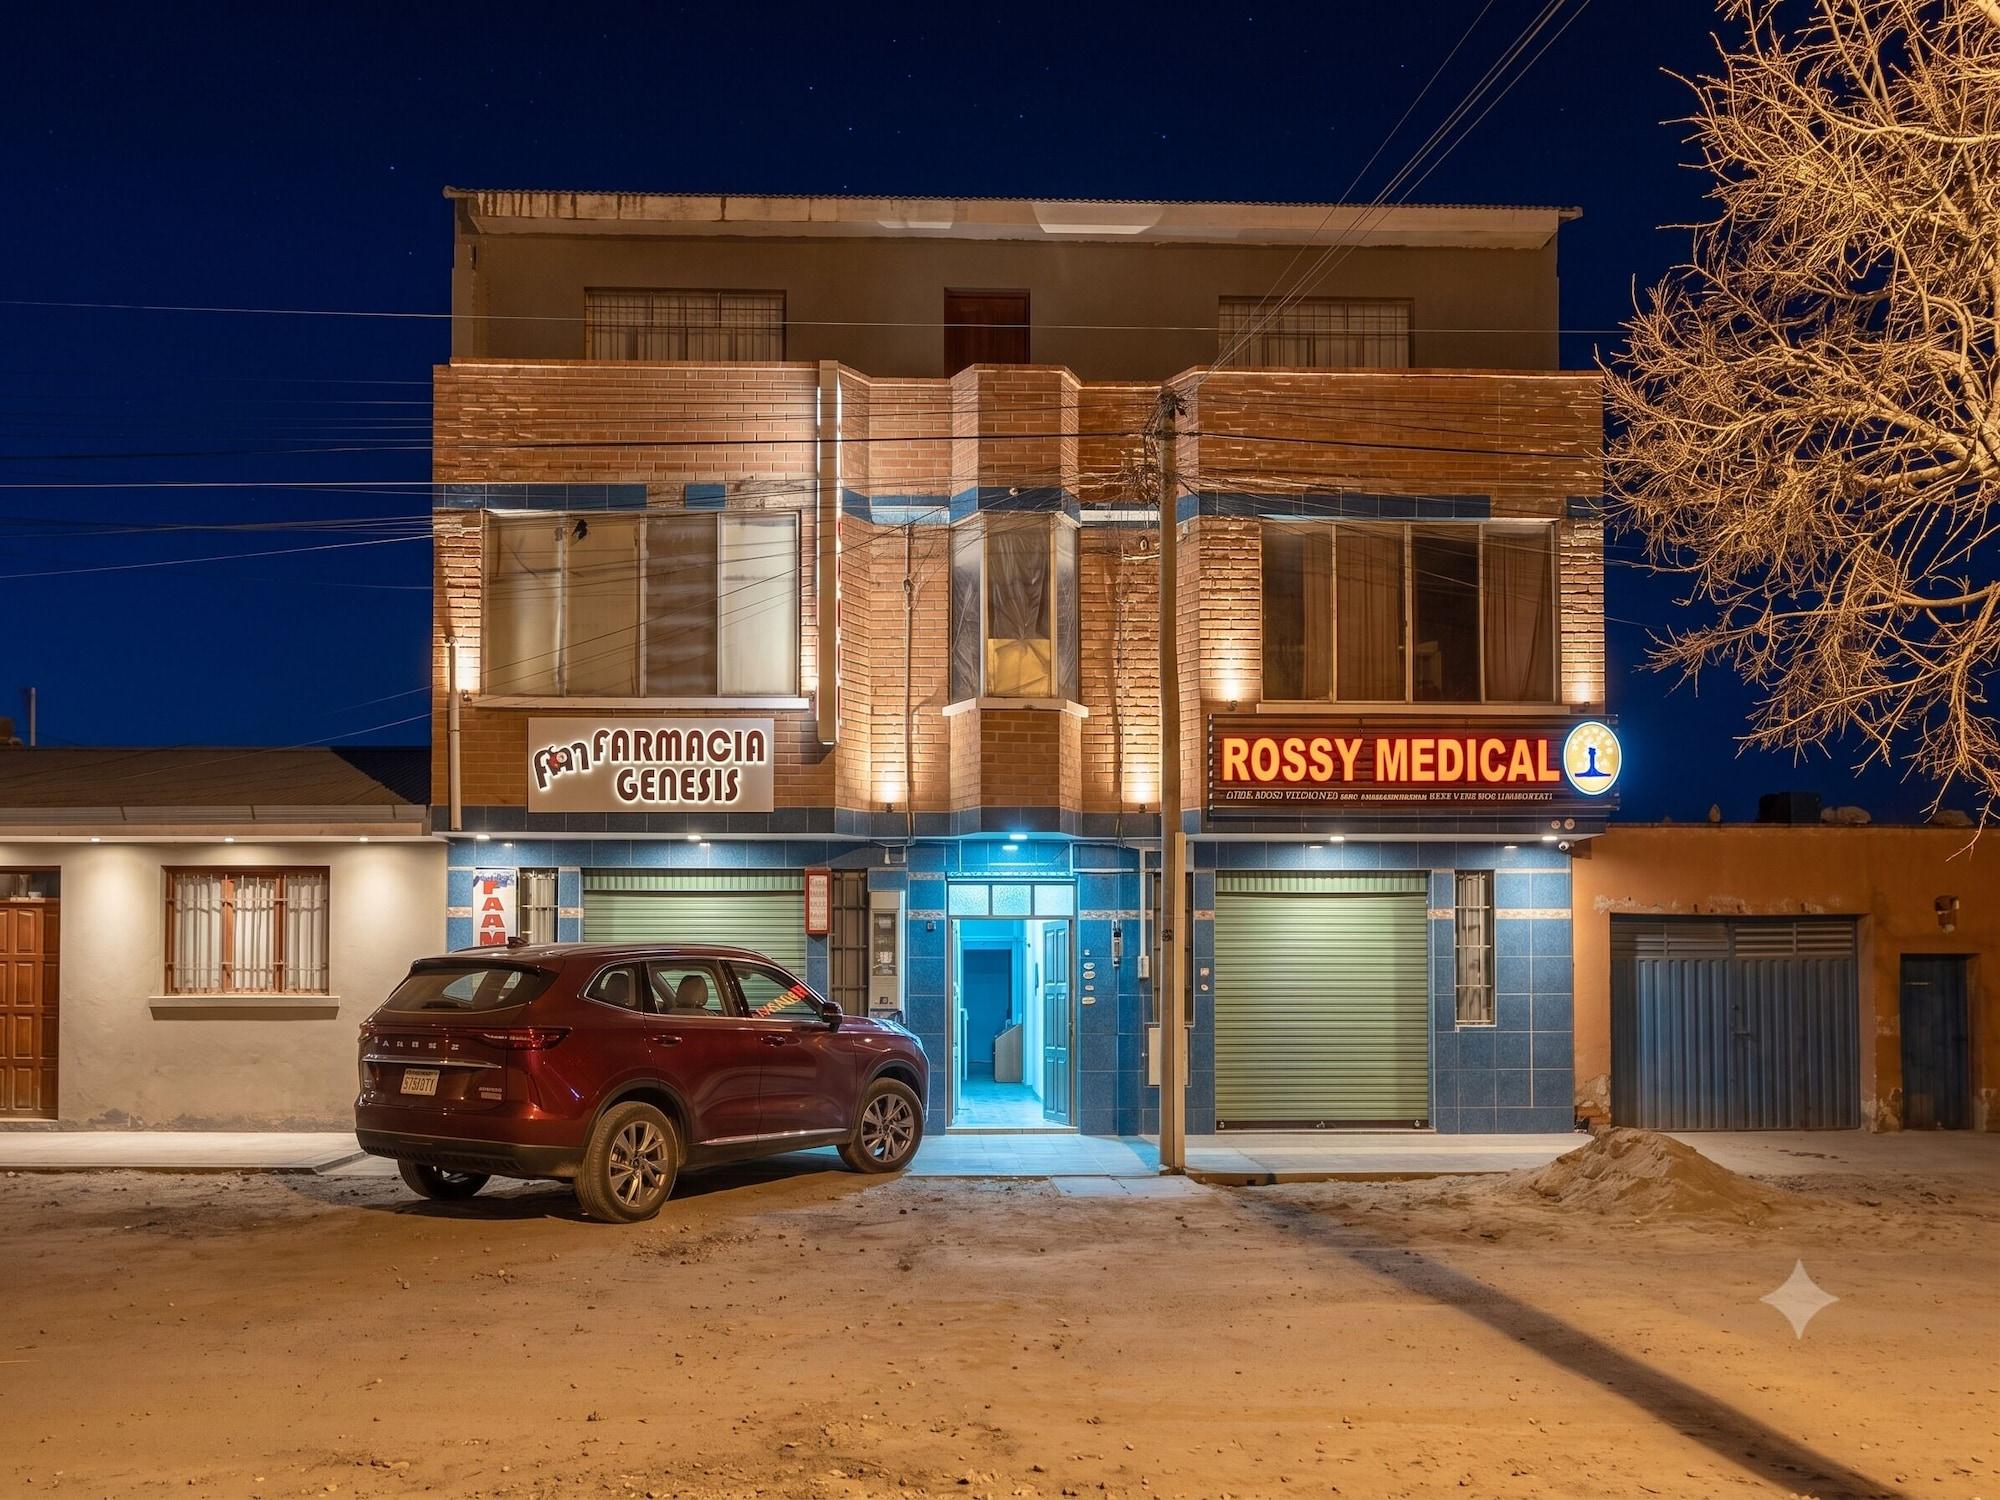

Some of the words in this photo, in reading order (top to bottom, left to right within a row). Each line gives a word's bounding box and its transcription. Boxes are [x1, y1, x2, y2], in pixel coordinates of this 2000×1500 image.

[592, 729, 765, 762] FARMACIA
[1222, 737, 1364, 782] ROSSY
[1375, 738, 1561, 782] MEDICAL
[616, 768, 739, 801] GENESIS
